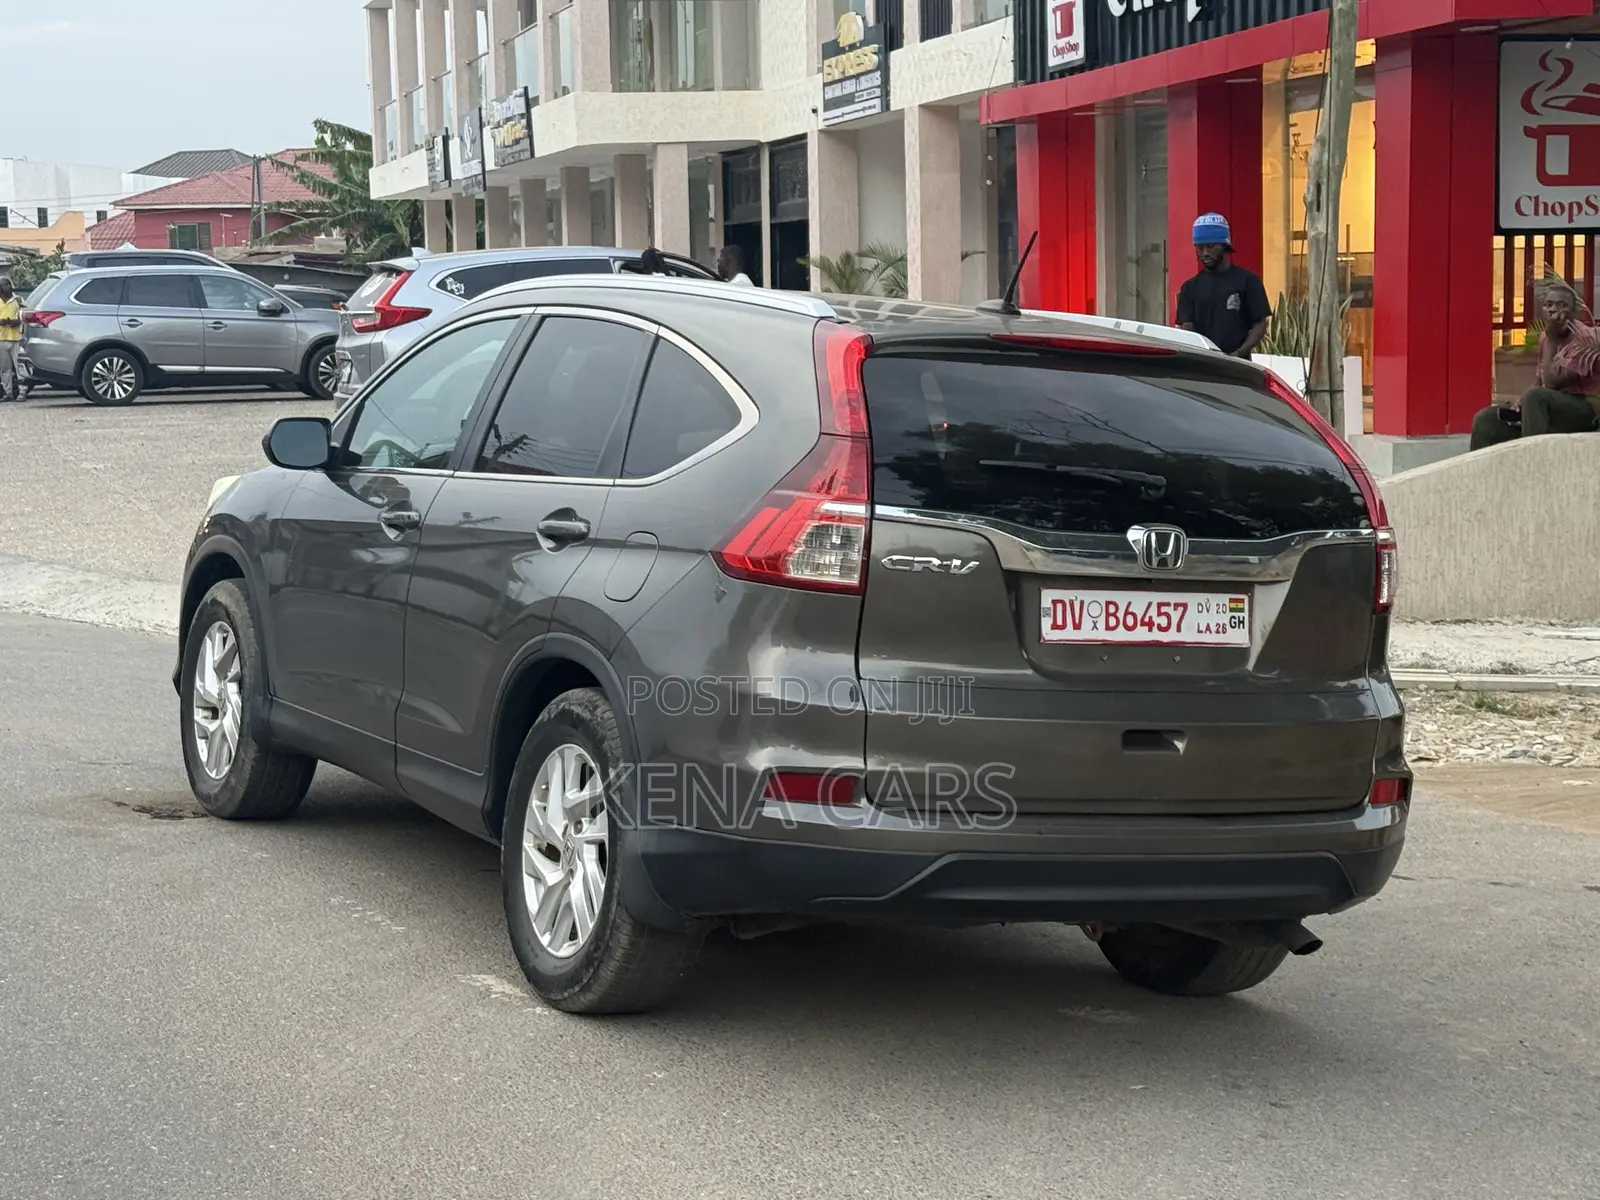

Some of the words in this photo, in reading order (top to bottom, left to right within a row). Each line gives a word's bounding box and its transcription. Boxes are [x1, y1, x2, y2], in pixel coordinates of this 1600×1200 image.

[1052, 41, 1080, 59] ChopShop
[1514, 194, 1600, 224] ChopS
[881, 555, 980, 575] CR-V
[1050, 598, 1085, 631] DV
[1104, 600, 1189, 633] B6457
[1196, 602, 1211, 614] DV
[1215, 603, 1228, 615] 20
[1197, 622, 1212, 634] LA
[1215, 623, 1228, 635] 26
[1228, 615, 1246, 630] GH
